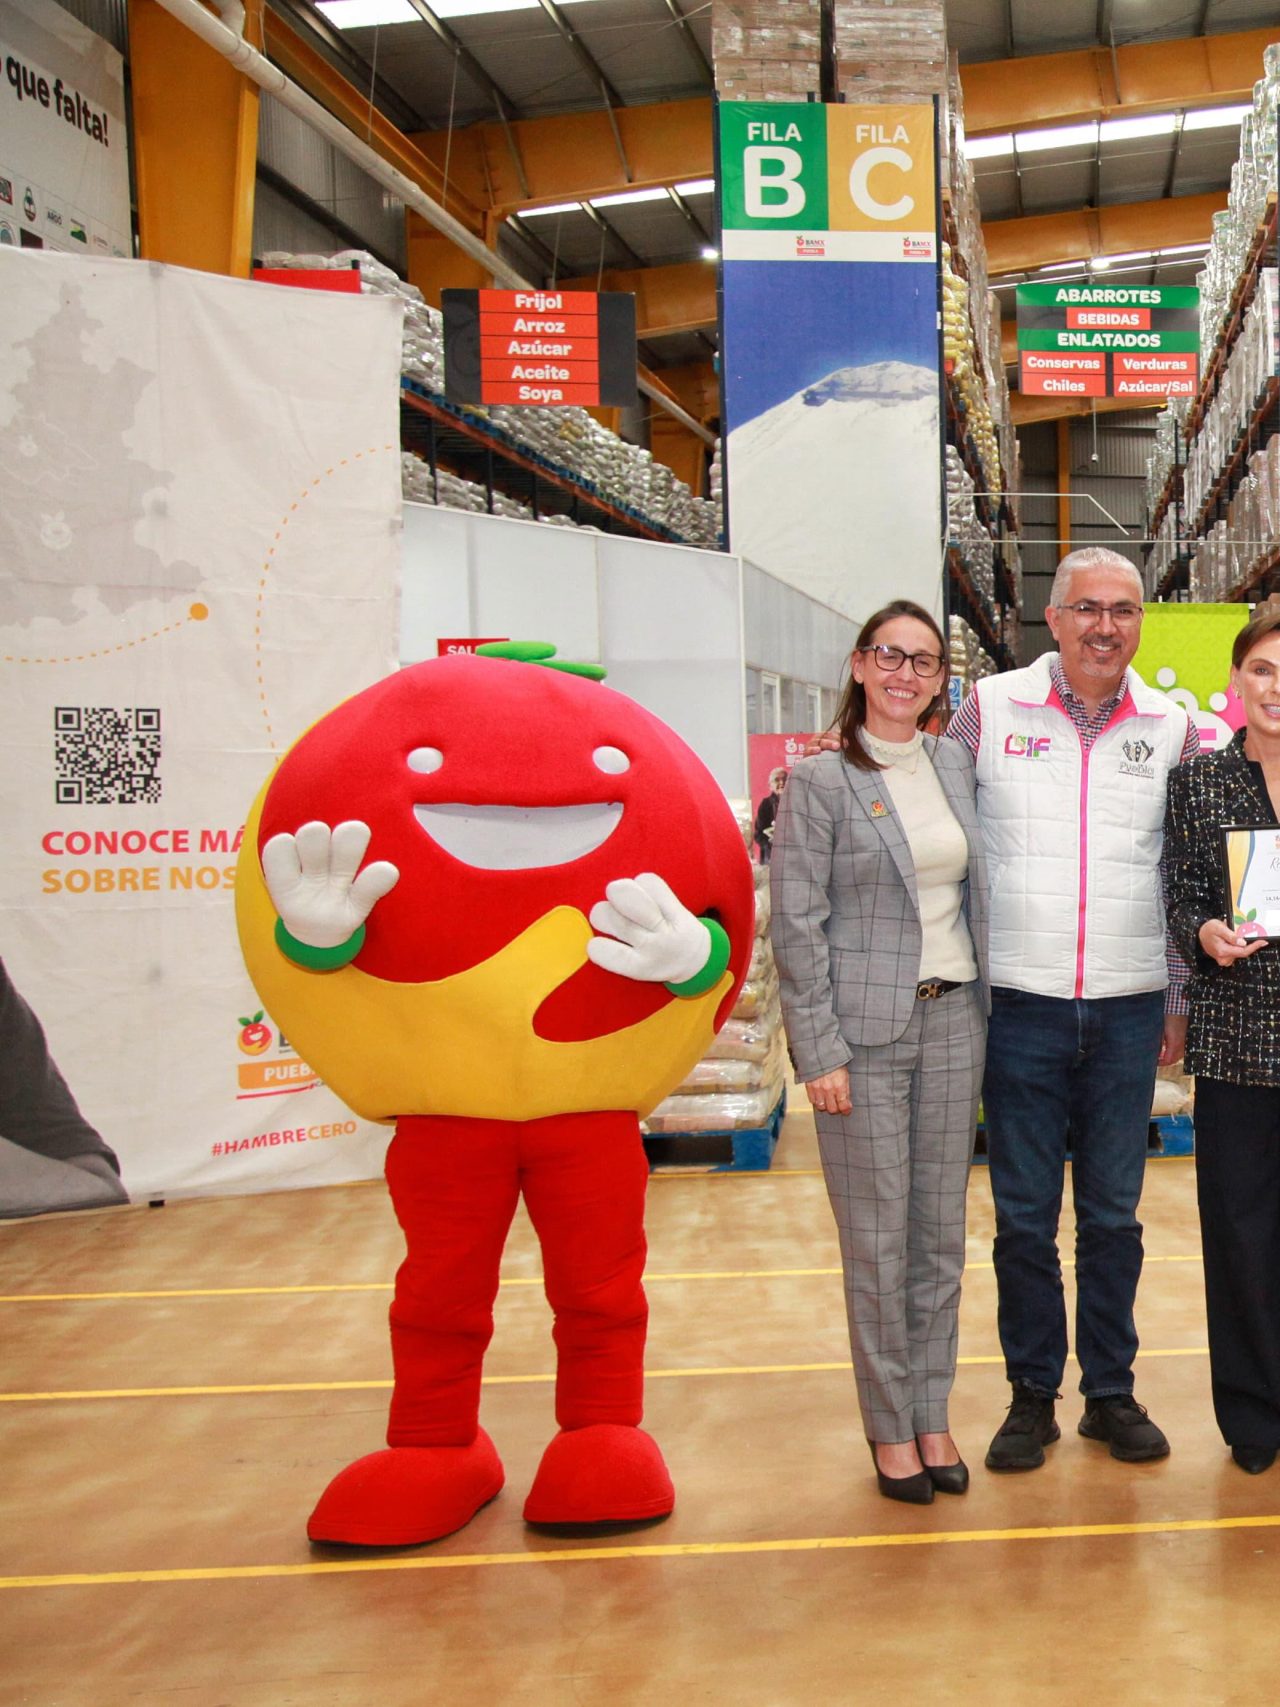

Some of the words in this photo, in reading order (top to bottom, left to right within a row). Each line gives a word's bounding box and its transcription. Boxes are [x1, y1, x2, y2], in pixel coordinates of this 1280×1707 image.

[6, 56, 50, 108] que
[53, 78, 109, 147] falta!
[747, 122, 802, 142] FILA
[855, 124, 910, 144] FILA
[743, 145, 806, 218] B
[849, 146, 915, 221] C
[514, 294, 563, 312] Frijol
[1055, 288, 1162, 304] ABARROTES
[513, 318, 565, 333] Arroz
[1077, 313, 1139, 326] BEBIDAS
[507, 340, 572, 356] Azúcar
[1057, 333, 1161, 347] ENLATADOS
[1027, 357, 1100, 370] Conservas
[1122, 358, 1187, 370] Verduras
[511, 365, 570, 380] Aceite
[1043, 379, 1086, 391] Chiles
[1118, 381, 1193, 395] Azúcar/Sal
[519, 386, 563, 403] Soya
[41, 829, 190, 856] CONOCE
[199, 824, 246, 853] MÁ
[41, 867, 160, 894] SOBRE
[169, 865, 238, 890] NOS
[264, 1063, 316, 1082] PUEB
[212, 1120, 357, 1156] #HAMBRECERO
